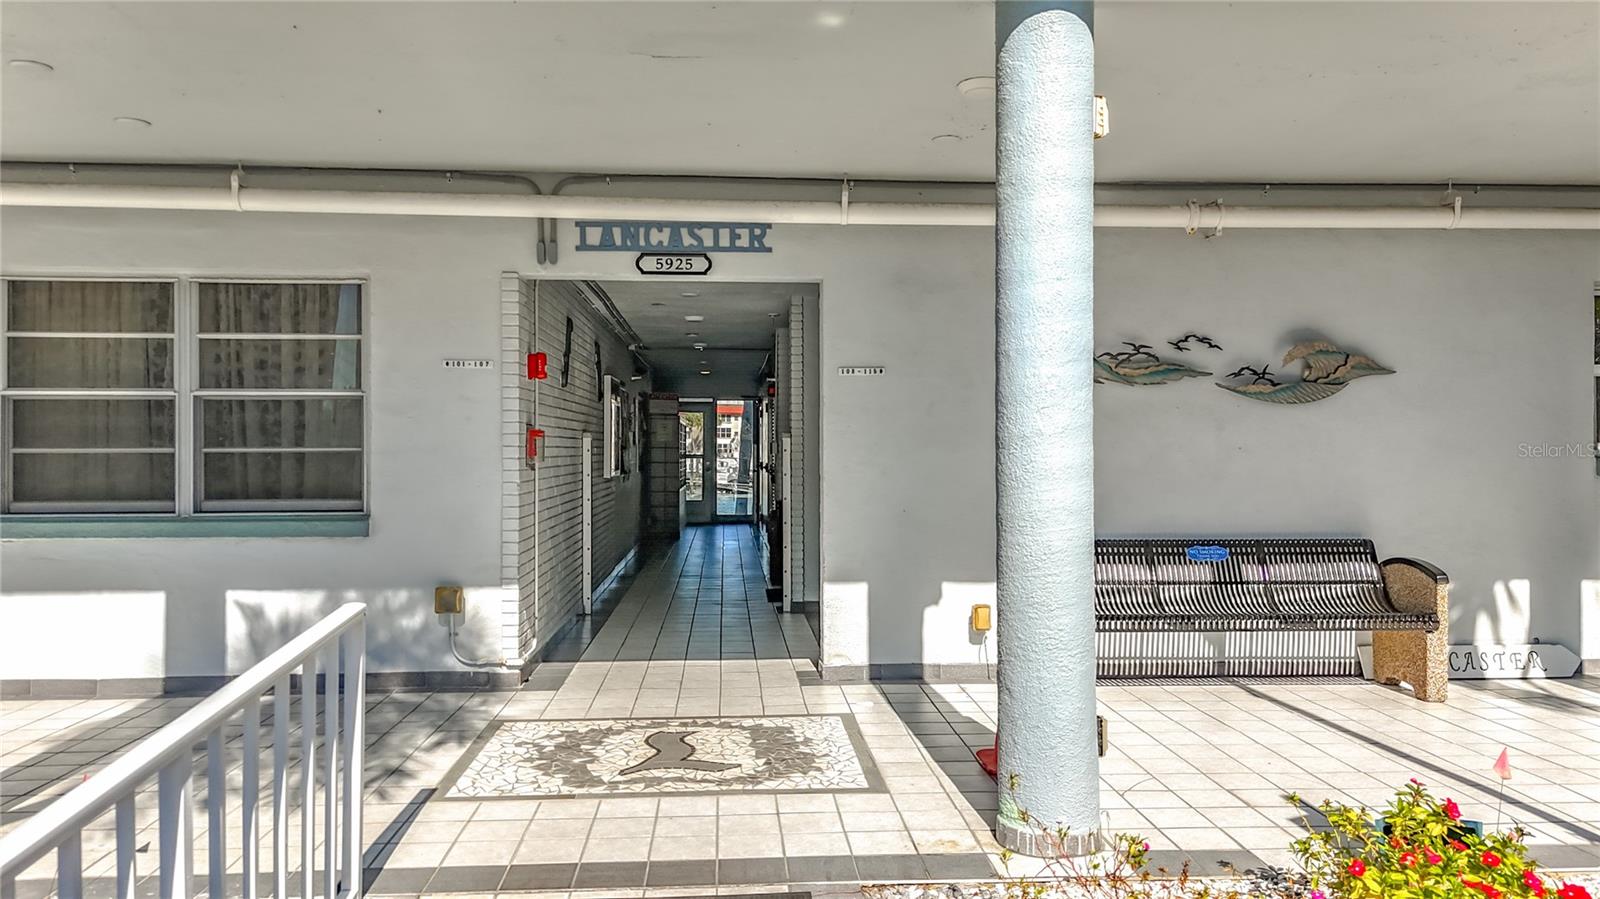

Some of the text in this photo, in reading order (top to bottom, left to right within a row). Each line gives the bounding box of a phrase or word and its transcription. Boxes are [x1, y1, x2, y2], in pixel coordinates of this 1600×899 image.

[575, 221, 773, 253] LANCASTER
[655, 257, 693, 270] 5925
[1448, 650, 1548, 673] CASTER
